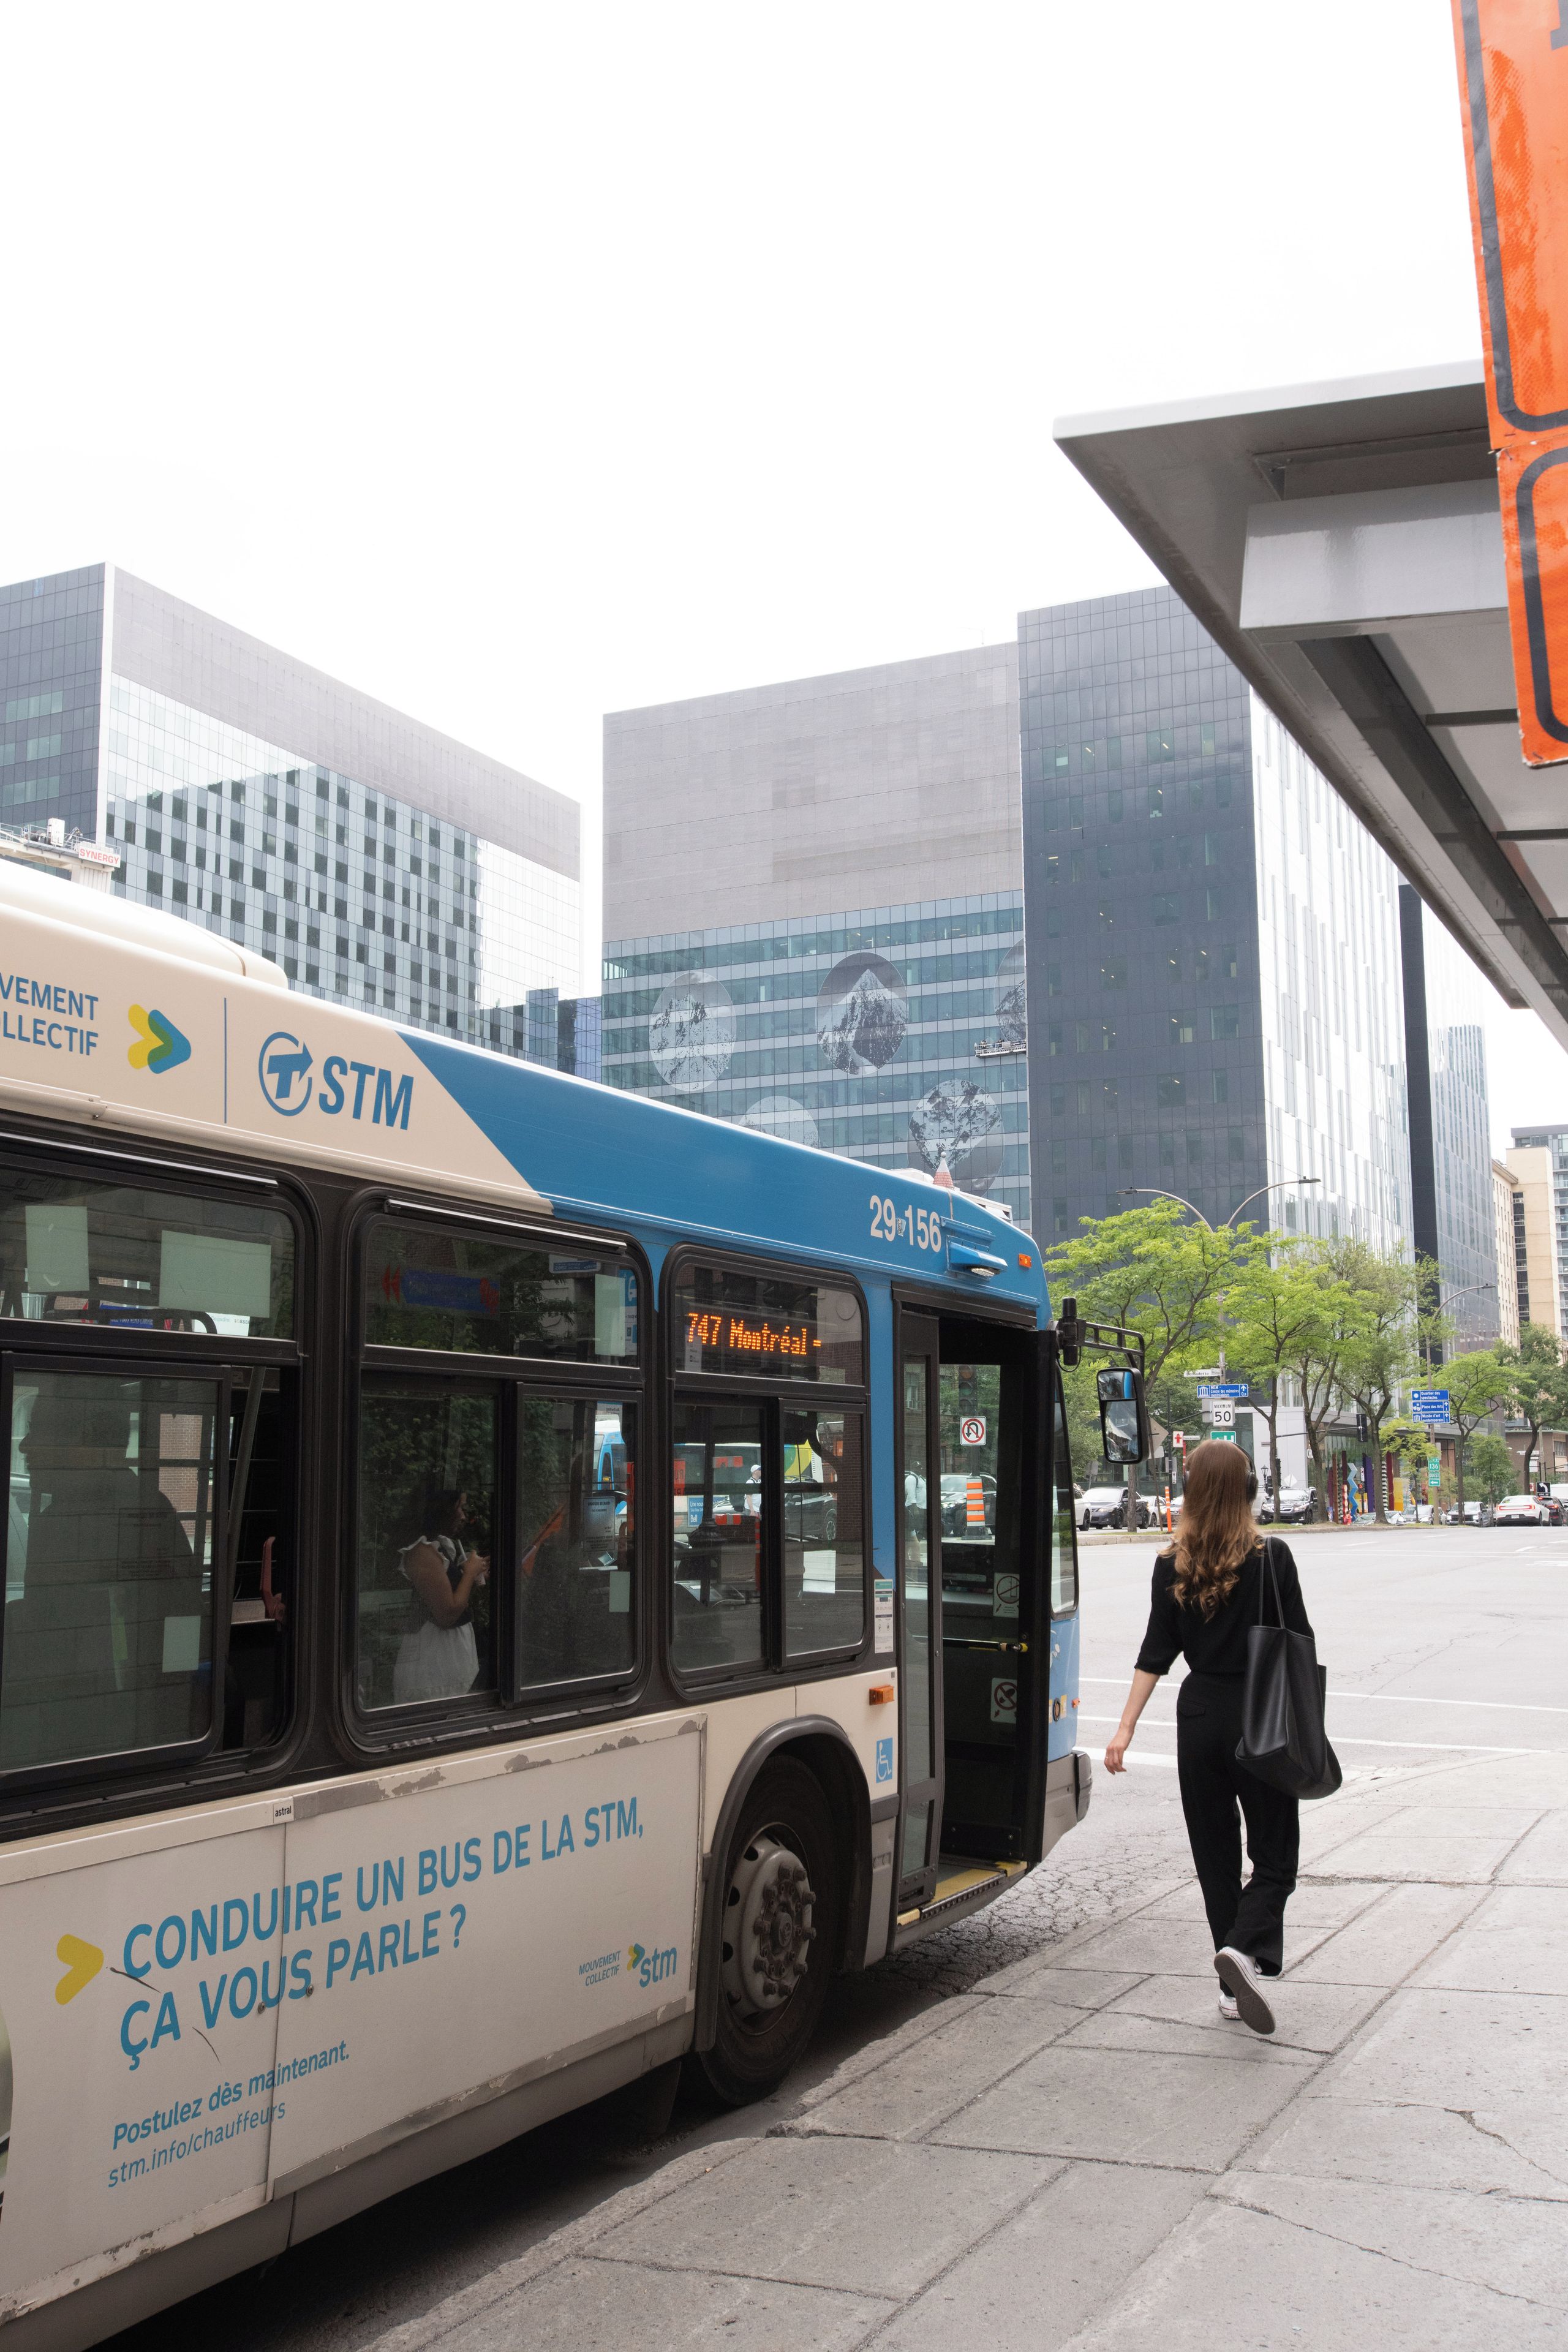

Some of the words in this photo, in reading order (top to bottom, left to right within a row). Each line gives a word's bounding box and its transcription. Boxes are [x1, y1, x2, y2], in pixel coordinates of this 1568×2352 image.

[80, 848, 119, 865] SYNERGY
[0, 1008, 99, 1056] LLECTIF
[318, 1055, 414, 1131] STM
[688, 1313, 722, 1346] 747
[730, 1319, 807, 1355] Montréal
[1215, 1411, 1231, 1422] 50
[274, 1805, 292, 1819] astral
[123, 1872, 342, 1979] CONDUIRE
[356, 1856, 405, 1912] UN
[418, 1838, 482, 1896] BUS
[493, 1824, 530, 1875] DE
[542, 1814, 575, 1861] LA
[584, 1796, 643, 1848] STM,
[579, 1951, 621, 1976] MOUVEMENT
[585, 1964, 620, 1987] COLLECTIF
[639, 1947, 677, 1988] stm
[120, 1991, 181, 2071] ÇA
[198, 1950, 313, 2029] VOUS
[326, 1910, 441, 1989] PARLE
[113, 2098, 203, 2150] Postulez
[208, 2082, 243, 2112] dès
[248, 2040, 350, 2097] maintenant.
[108, 2102, 286, 2188] stm.info/chauffeurs
